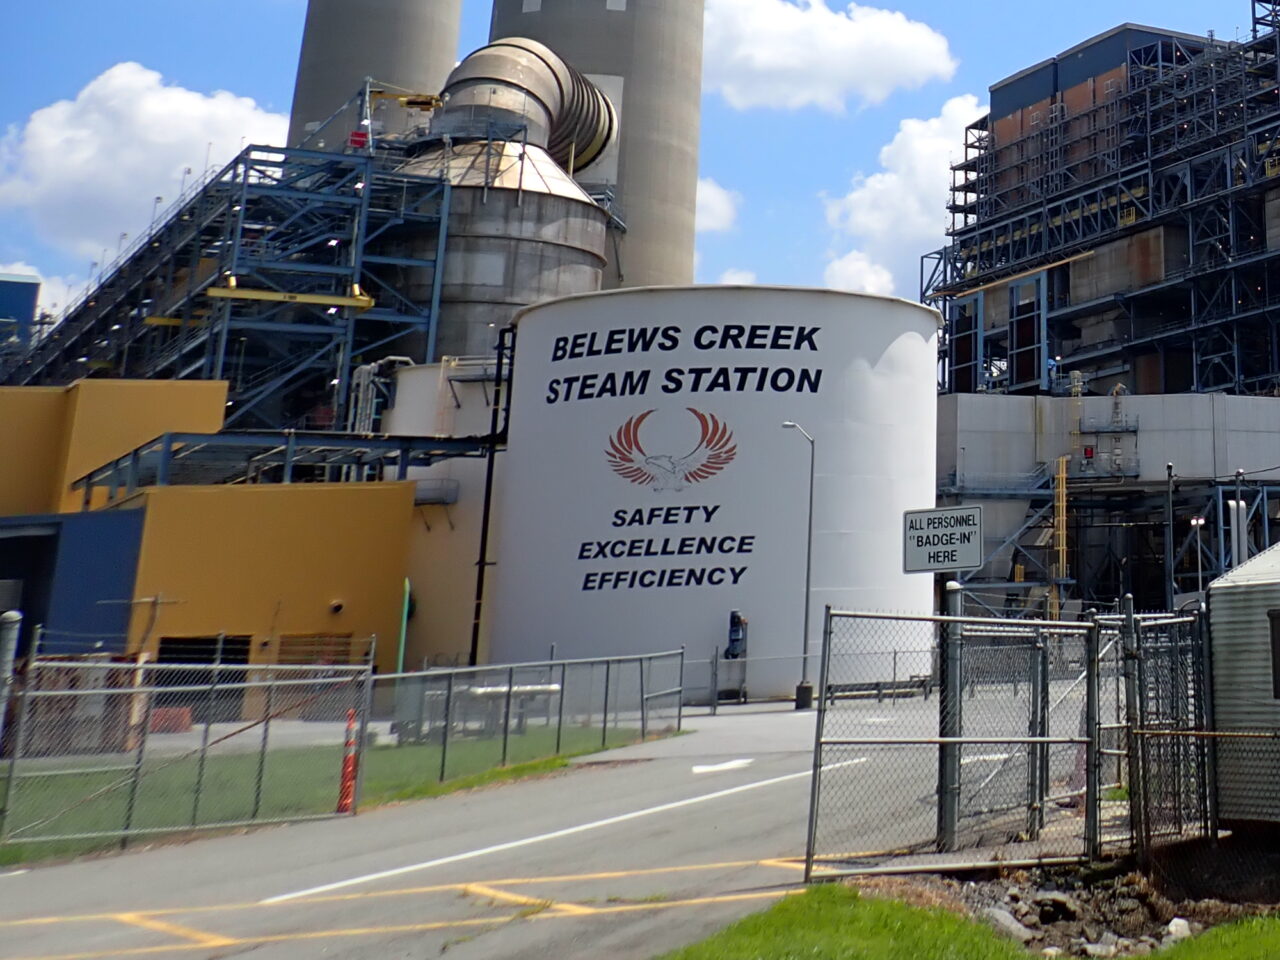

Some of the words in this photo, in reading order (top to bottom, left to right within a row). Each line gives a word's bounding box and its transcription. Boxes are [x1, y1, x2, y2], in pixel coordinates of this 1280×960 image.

[551, 326, 682, 362] BELEWS
[693, 325, 822, 351] CREEK
[546, 369, 651, 404] STEAM
[661, 367, 823, 393] STATION
[612, 505, 720, 527] SAFETY
[909, 518, 925, 531] ALL
[927, 514, 977, 530] PERSONNEL
[577, 535, 756, 560] EXCELLENCE
[928, 550, 958, 564] HERE
[581, 566, 748, 591] EFFICIENCY
